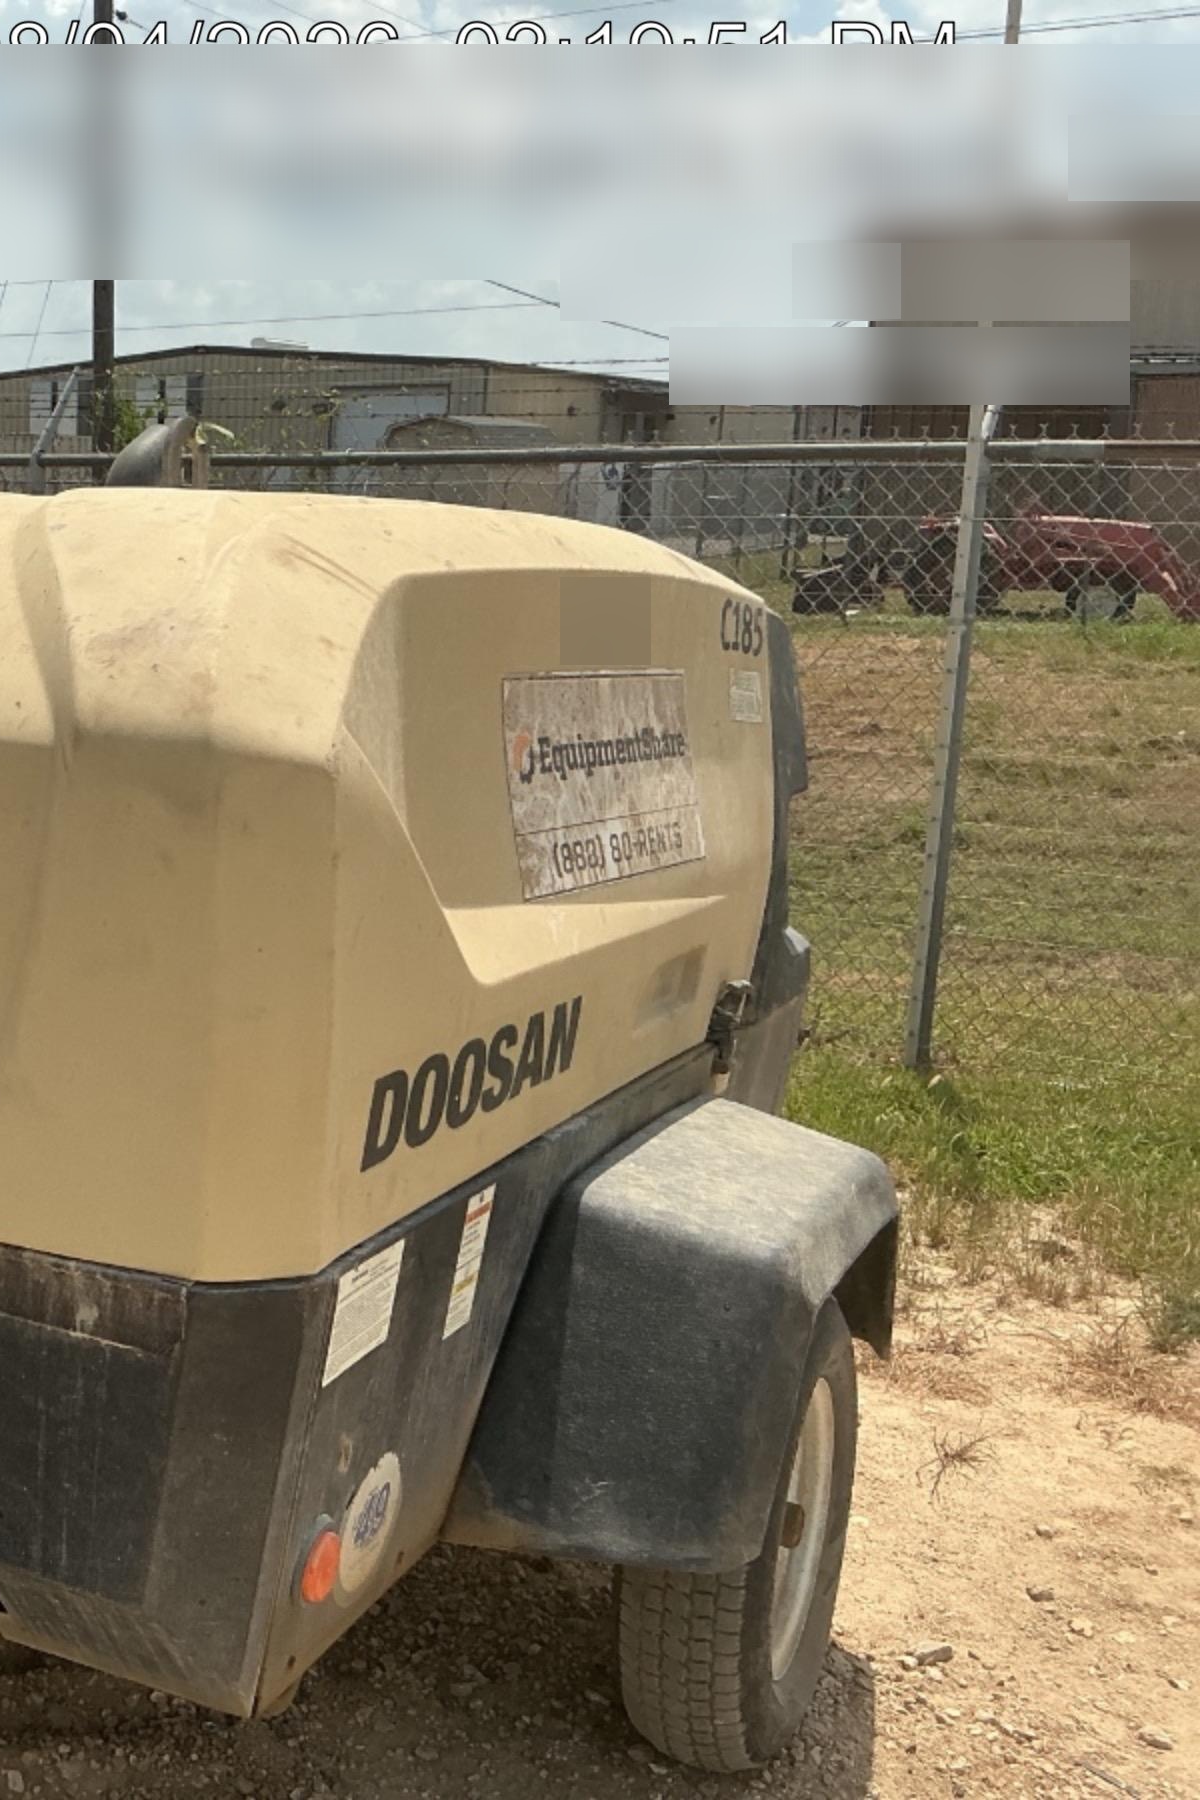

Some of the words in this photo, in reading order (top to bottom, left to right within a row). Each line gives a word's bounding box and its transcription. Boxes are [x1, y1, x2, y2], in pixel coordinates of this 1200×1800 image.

[720, 597, 764, 656] C185
[537, 727, 686, 781] EquipmentShare
[360, 995, 583, 1173] DOOSAN
